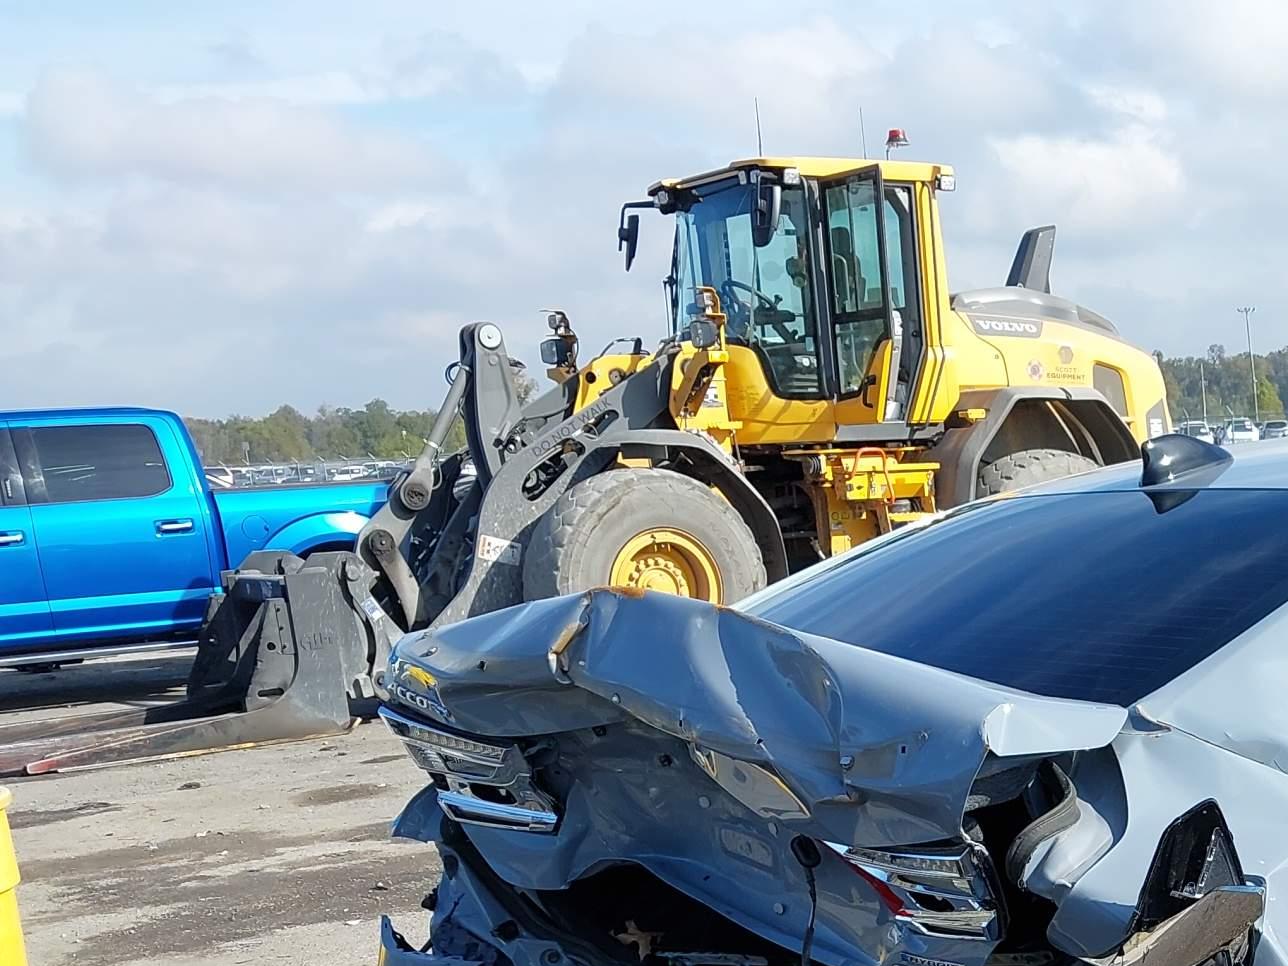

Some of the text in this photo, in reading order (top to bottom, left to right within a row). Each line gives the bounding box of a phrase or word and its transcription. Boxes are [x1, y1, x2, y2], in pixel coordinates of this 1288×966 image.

[975, 319, 1037, 333] VOLVO
[1046, 372, 1086, 381] EQUIPMENT
[531, 397, 614, 457] DO NOT WALK
